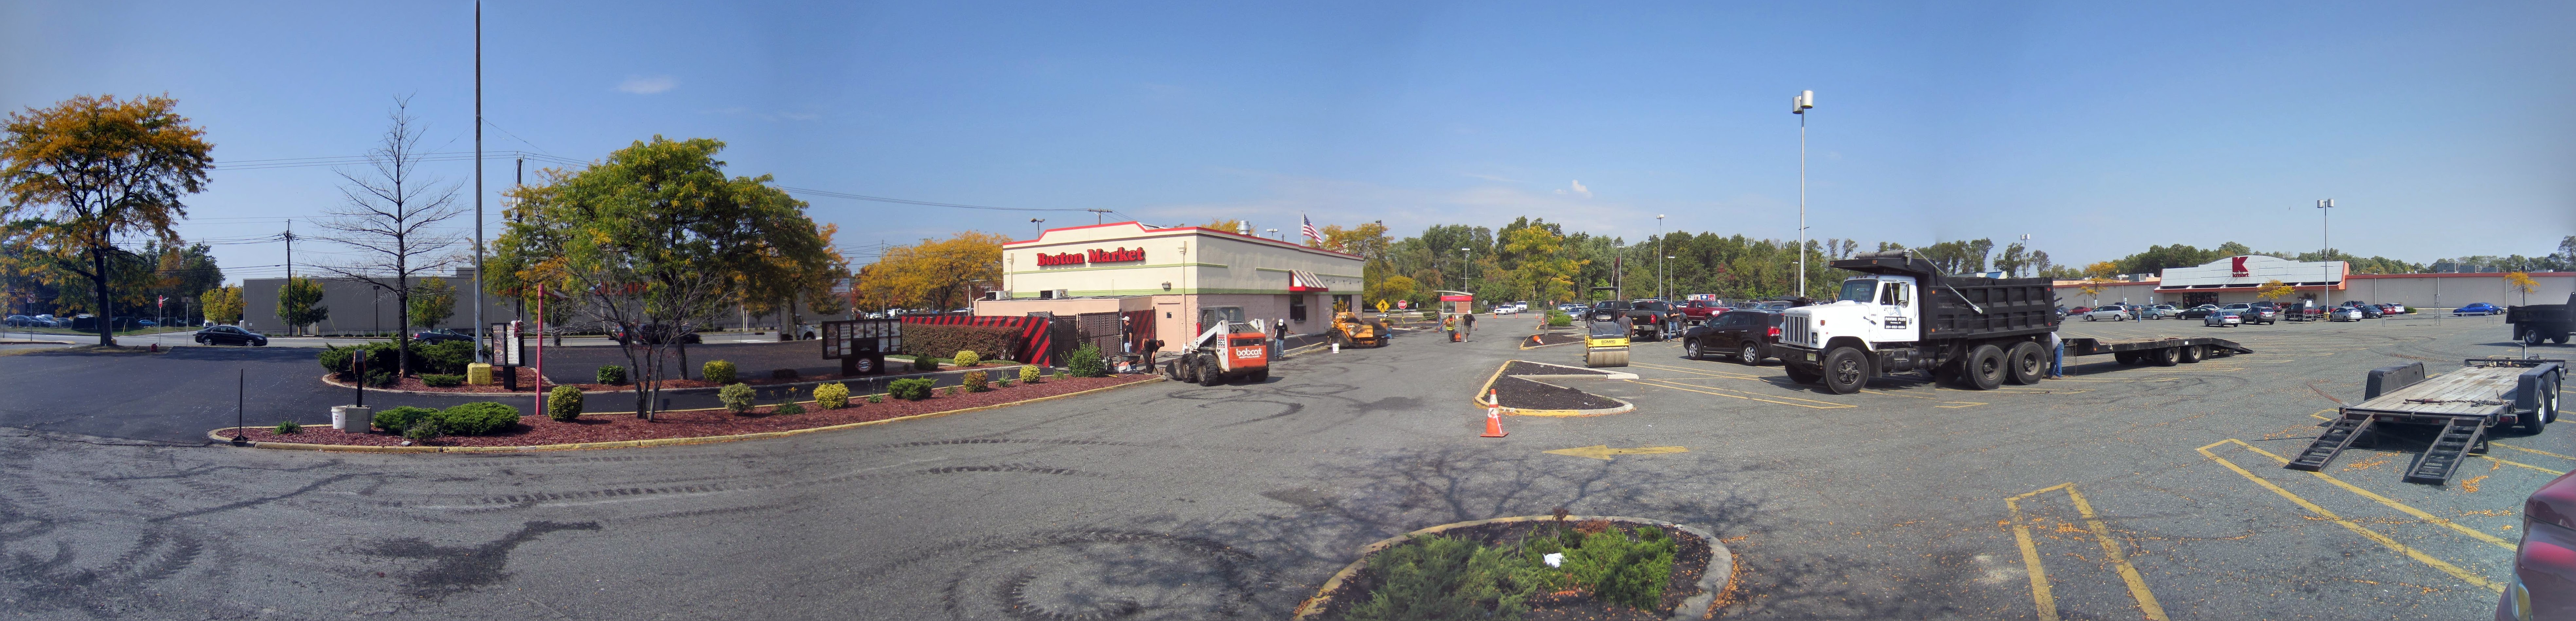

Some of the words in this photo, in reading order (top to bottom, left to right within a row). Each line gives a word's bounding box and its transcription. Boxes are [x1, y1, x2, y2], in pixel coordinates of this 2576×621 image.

[1037, 252, 1083, 266] Boston
[1087, 247, 1145, 263] Market
[2232, 257, 2248, 272] K
[1236, 348, 1262, 356] bobcat
